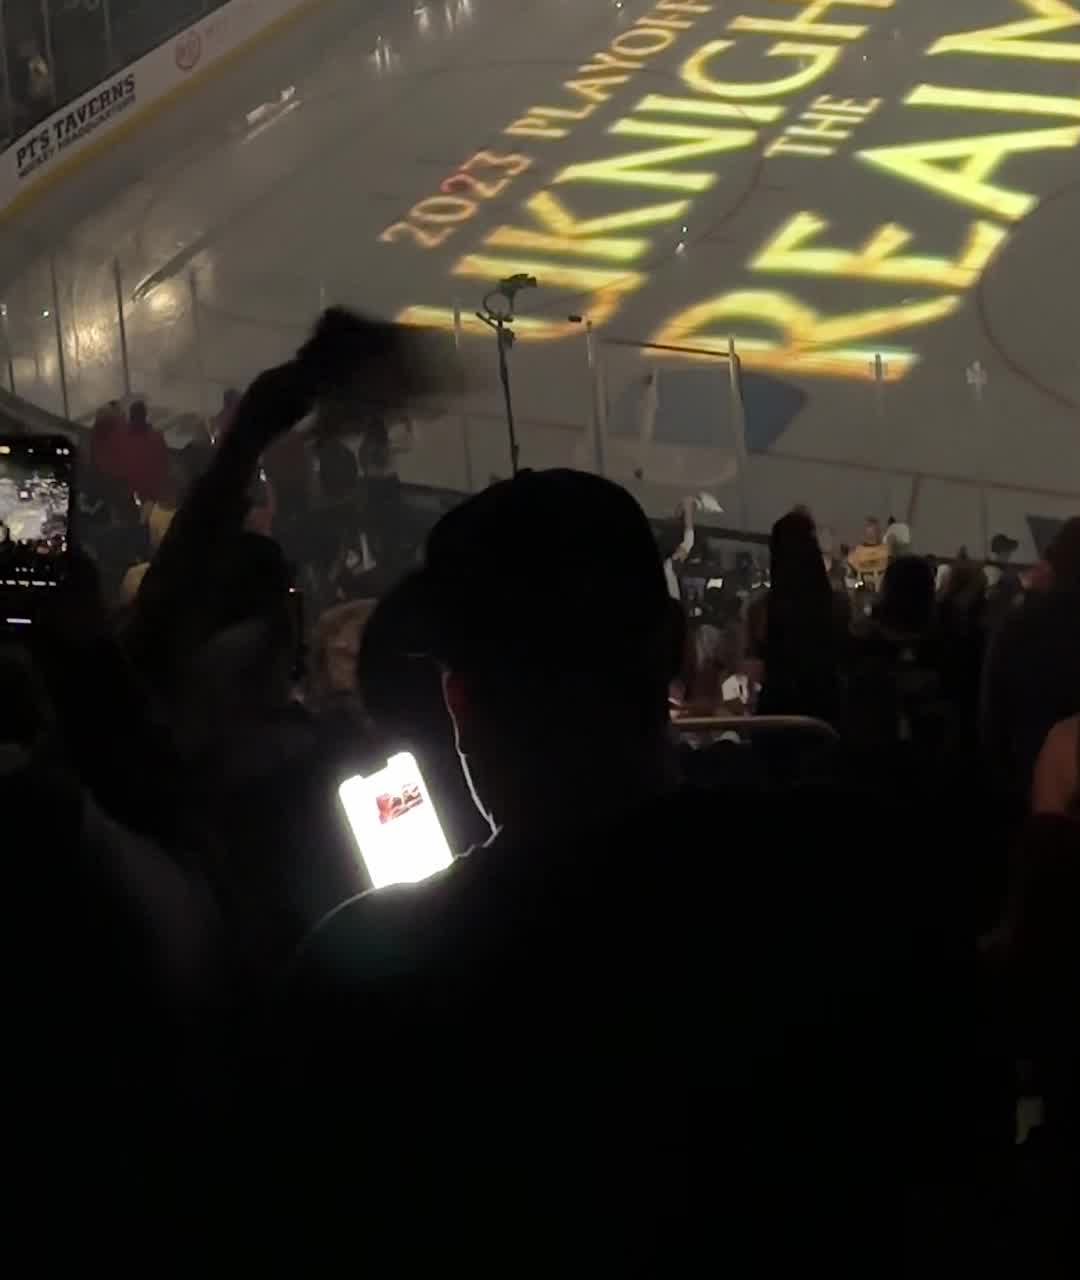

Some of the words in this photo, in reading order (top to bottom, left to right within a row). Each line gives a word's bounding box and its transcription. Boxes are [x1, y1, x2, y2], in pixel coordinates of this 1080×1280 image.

[54, 73, 136, 138] TAVERNS
[764, 94, 882, 159] THE
[380, 148, 532, 249] 2023
